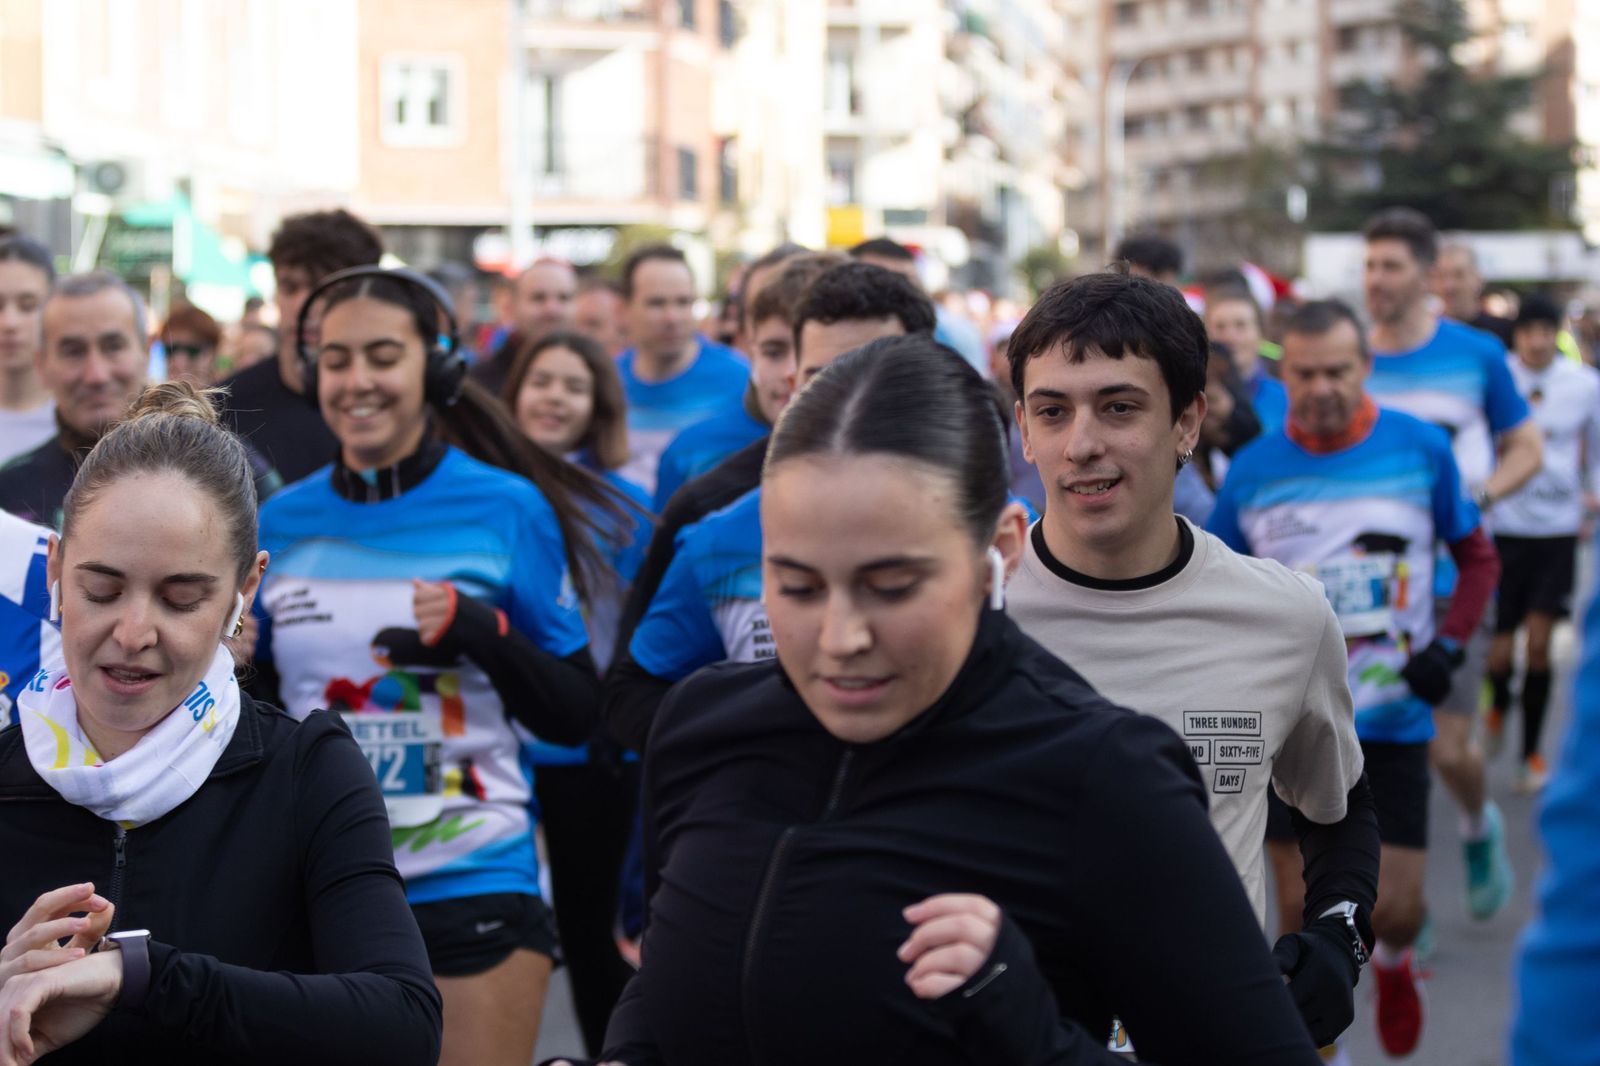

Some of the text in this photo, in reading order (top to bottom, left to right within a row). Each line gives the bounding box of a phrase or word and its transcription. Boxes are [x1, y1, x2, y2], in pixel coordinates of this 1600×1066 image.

[1189, 717, 1257, 729] THREE HUNDRED
[1190, 746, 1260, 757] ND SIXTY-FIVE
[1219, 775, 1240, 786] DAYS
